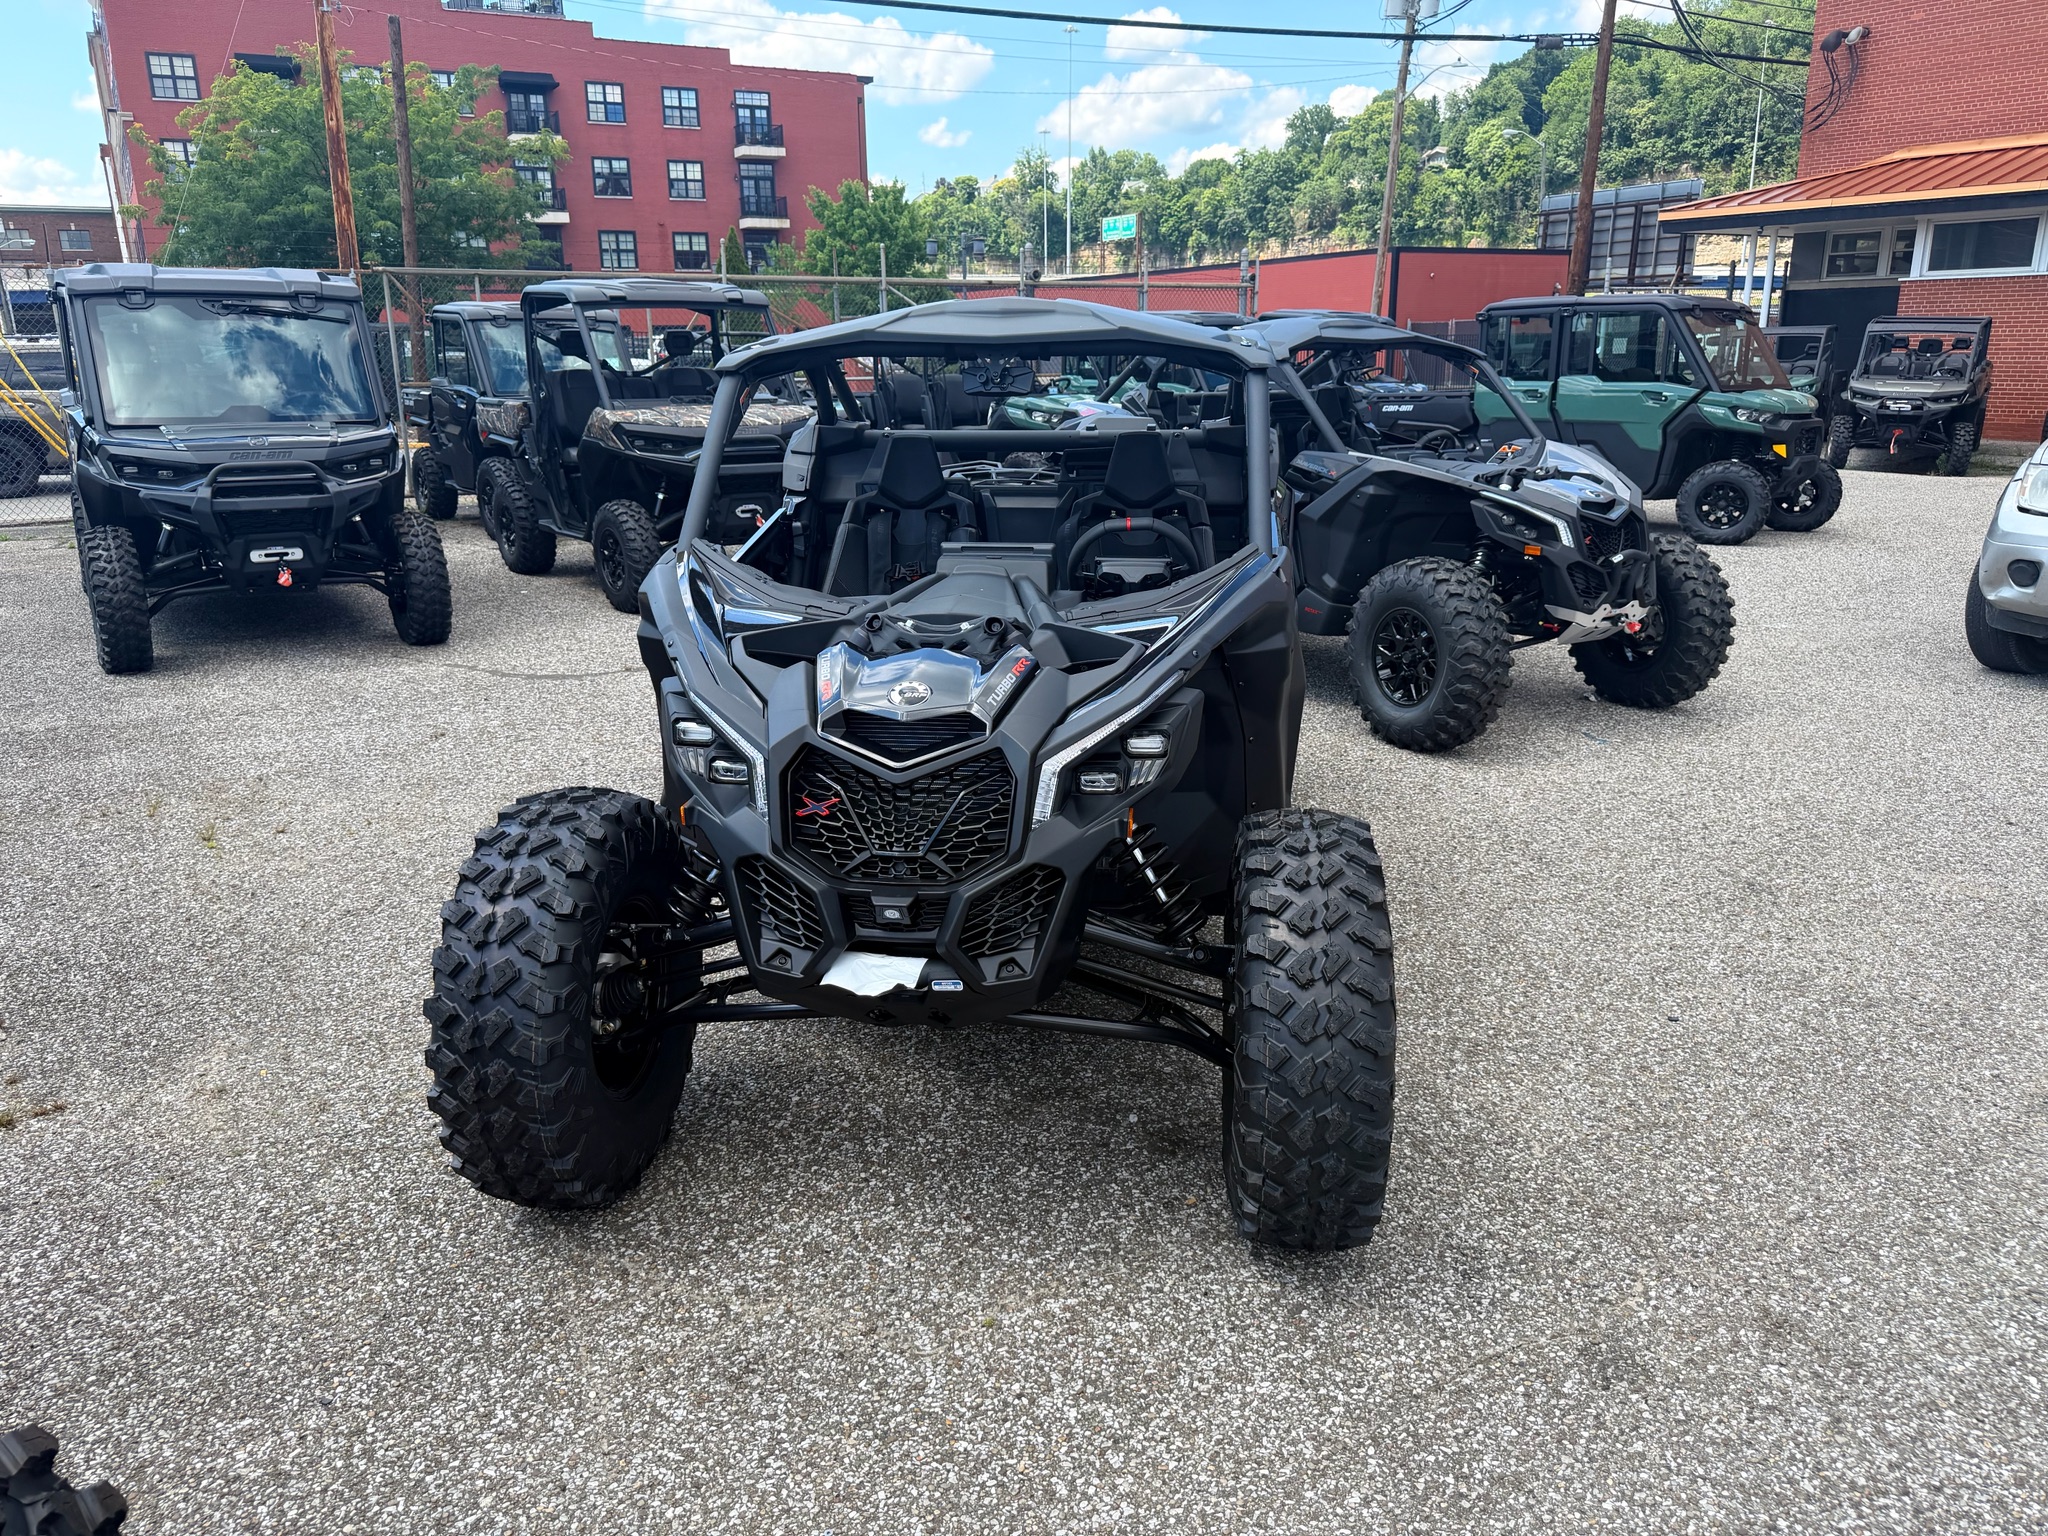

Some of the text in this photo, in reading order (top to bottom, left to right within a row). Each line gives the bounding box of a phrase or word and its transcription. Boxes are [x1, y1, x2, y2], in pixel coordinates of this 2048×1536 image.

[228, 451, 293, 460] can-am
[821, 652, 831, 680] TURBO
[986, 657, 1031, 706] TURBO RR
